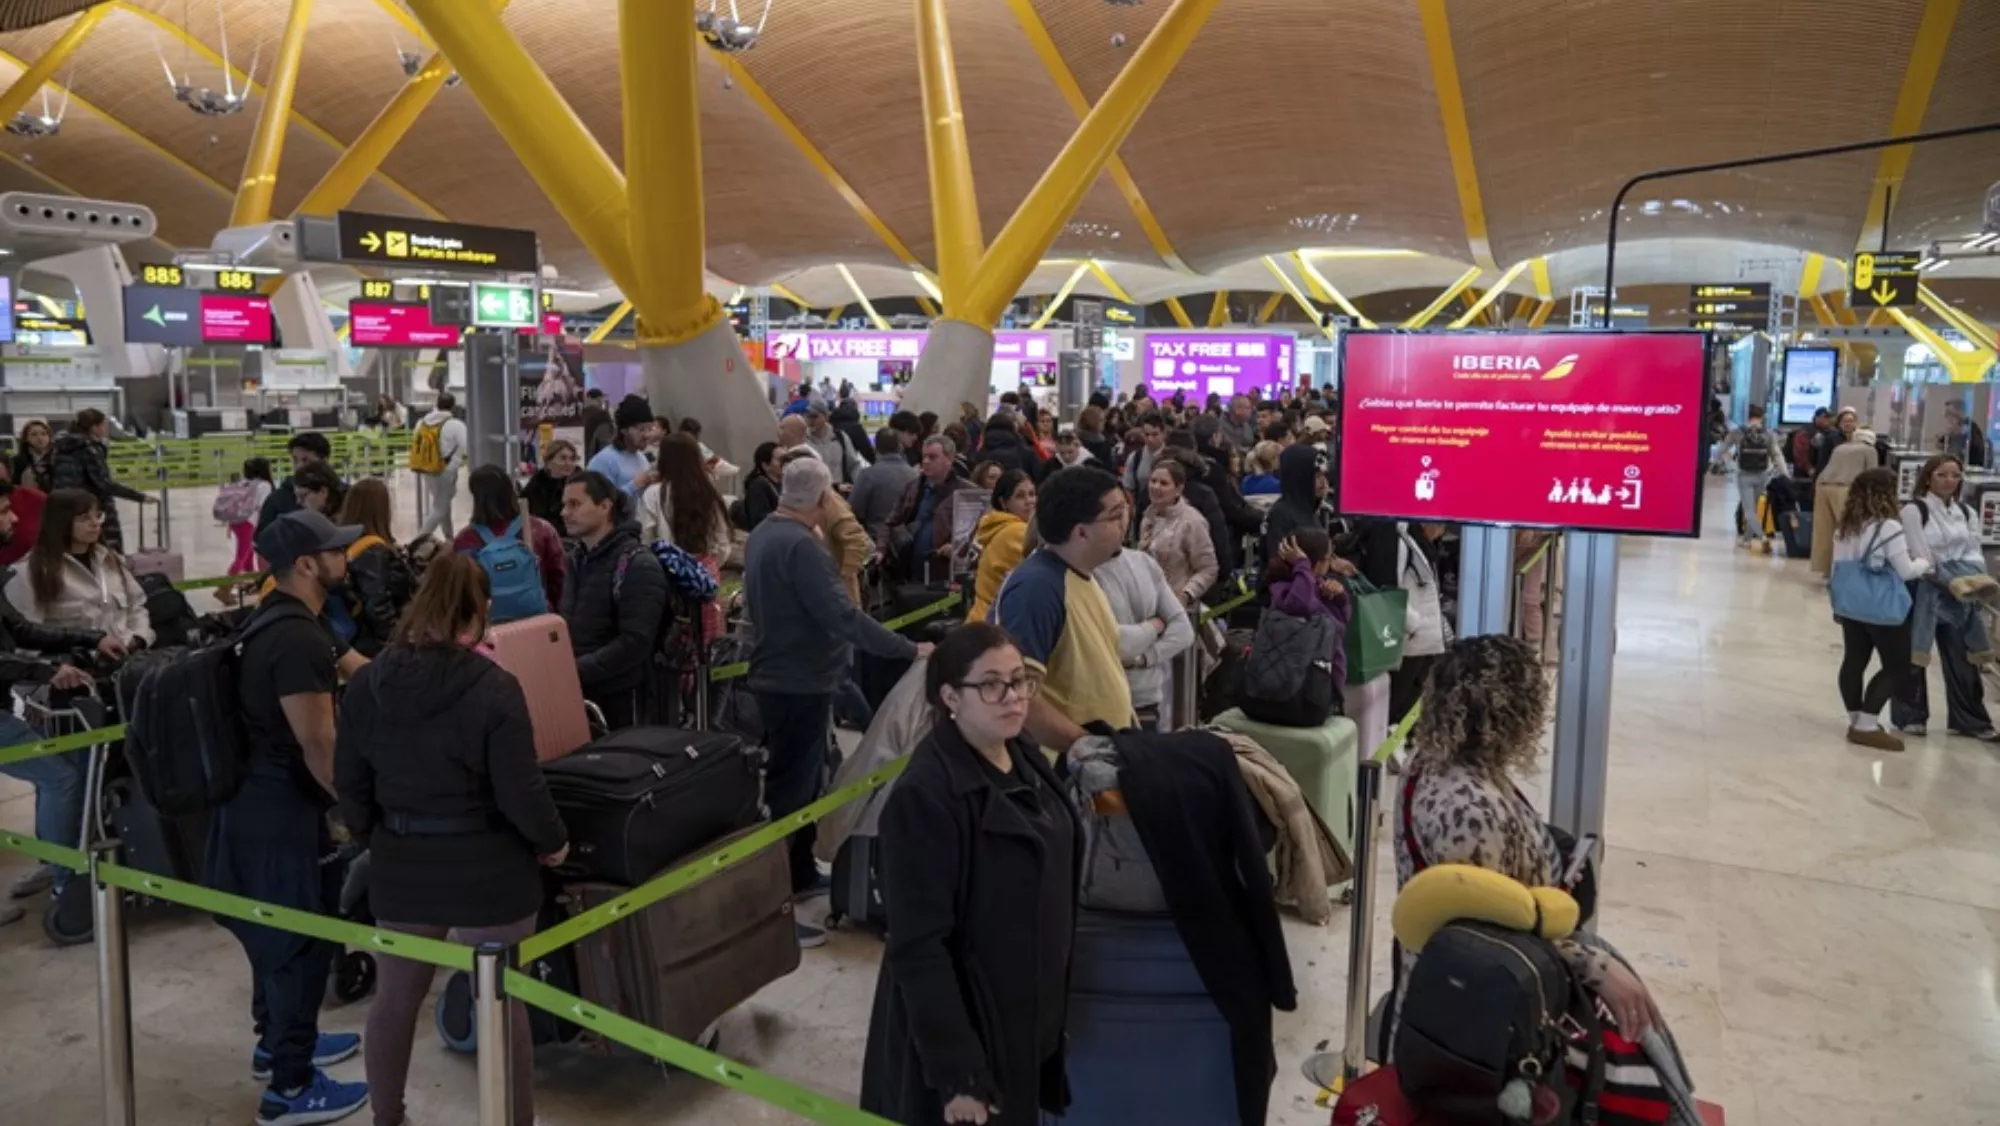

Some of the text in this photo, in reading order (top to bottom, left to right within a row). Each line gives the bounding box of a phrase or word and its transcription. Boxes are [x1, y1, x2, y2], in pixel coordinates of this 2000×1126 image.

[411, 246, 496, 264] Puertas de embarque
[144, 266, 181, 285] 885
[219, 271, 253, 289] 886
[364, 281, 392, 297] 887
[810, 338, 843, 356] TAX
[845, 338, 887, 356] FREE
[1150, 342, 1185, 356] TAX
[1188, 342, 1232, 356] FREE
[1453, 355, 1541, 370] IBERIA
[1395, 400, 1414, 410] que
[1415, 400, 1442, 409] Iberia
[1444, 400, 1454, 409] te
[1455, 401, 1494, 411] permite
[1495, 400, 1535, 411] facturar
[1537, 402, 1549, 412] tu
[1551, 402, 1594, 414] equipaje
[1596, 403, 1610, 413] de
[1612, 405, 1643, 414] mano
[1644, 404, 1683, 417] gratis?
[1429, 425, 1440, 434] de
[1453, 427, 1489, 437] equipaje
[1601, 443, 1650, 453] embarque
